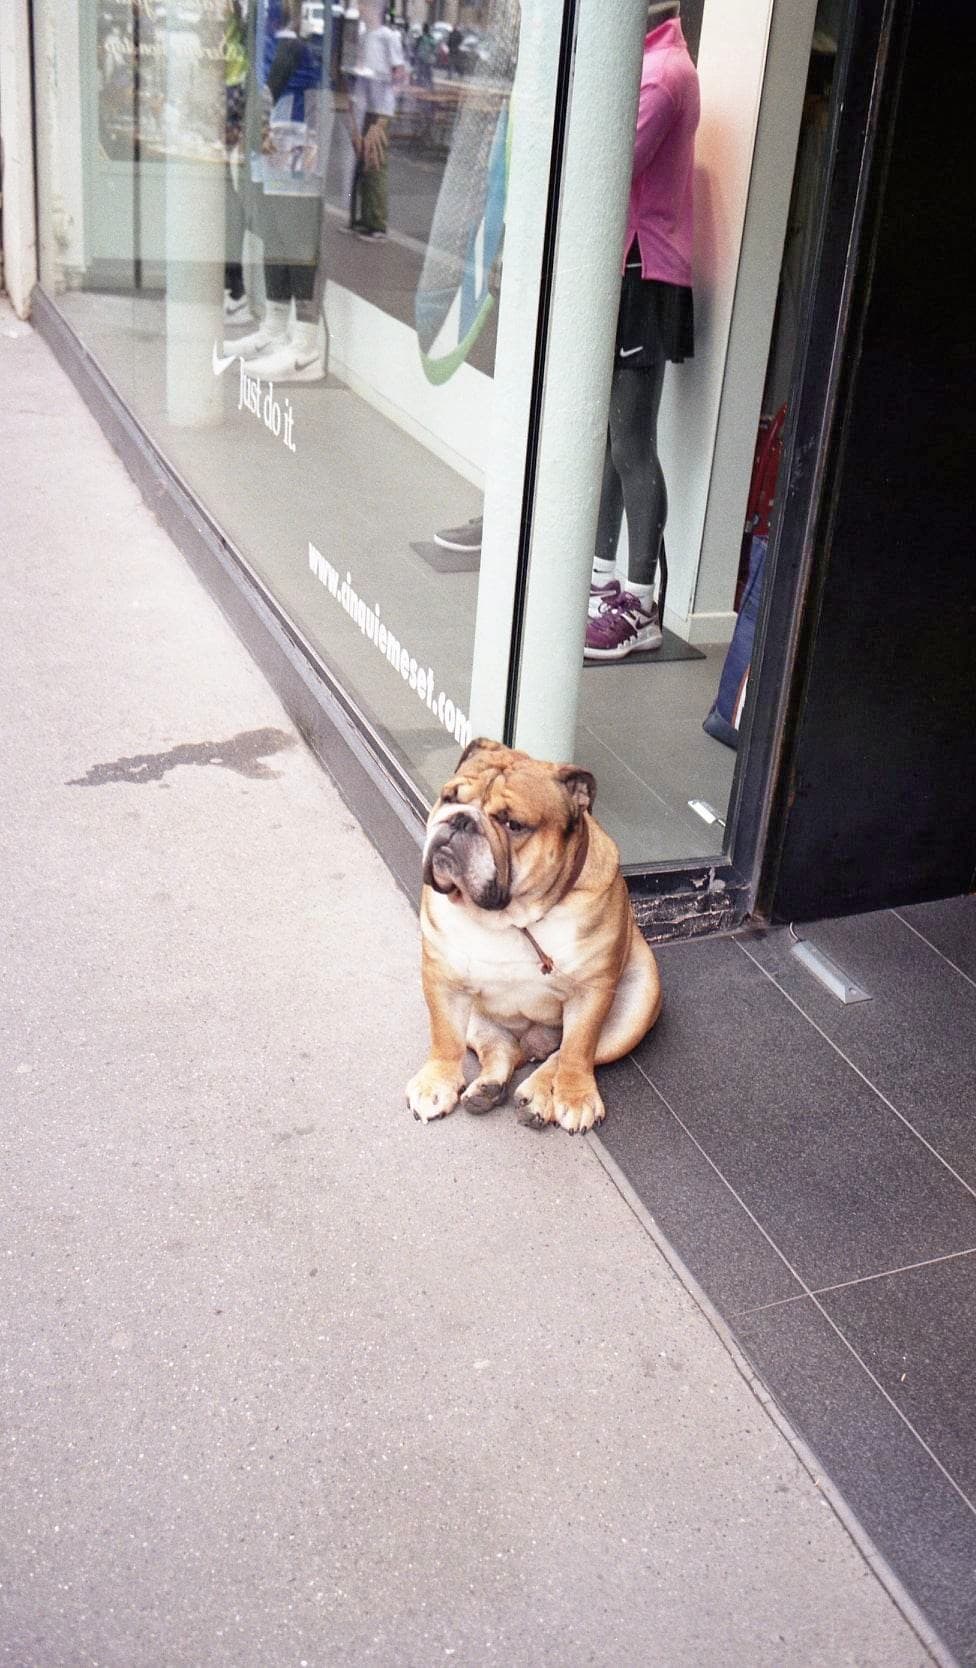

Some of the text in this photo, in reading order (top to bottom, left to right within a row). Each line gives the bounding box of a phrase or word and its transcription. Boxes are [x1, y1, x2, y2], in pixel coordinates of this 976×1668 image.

[238, 357, 296, 453] Just do it.
[308, 541, 472, 749] www.cinquiemeset.com
